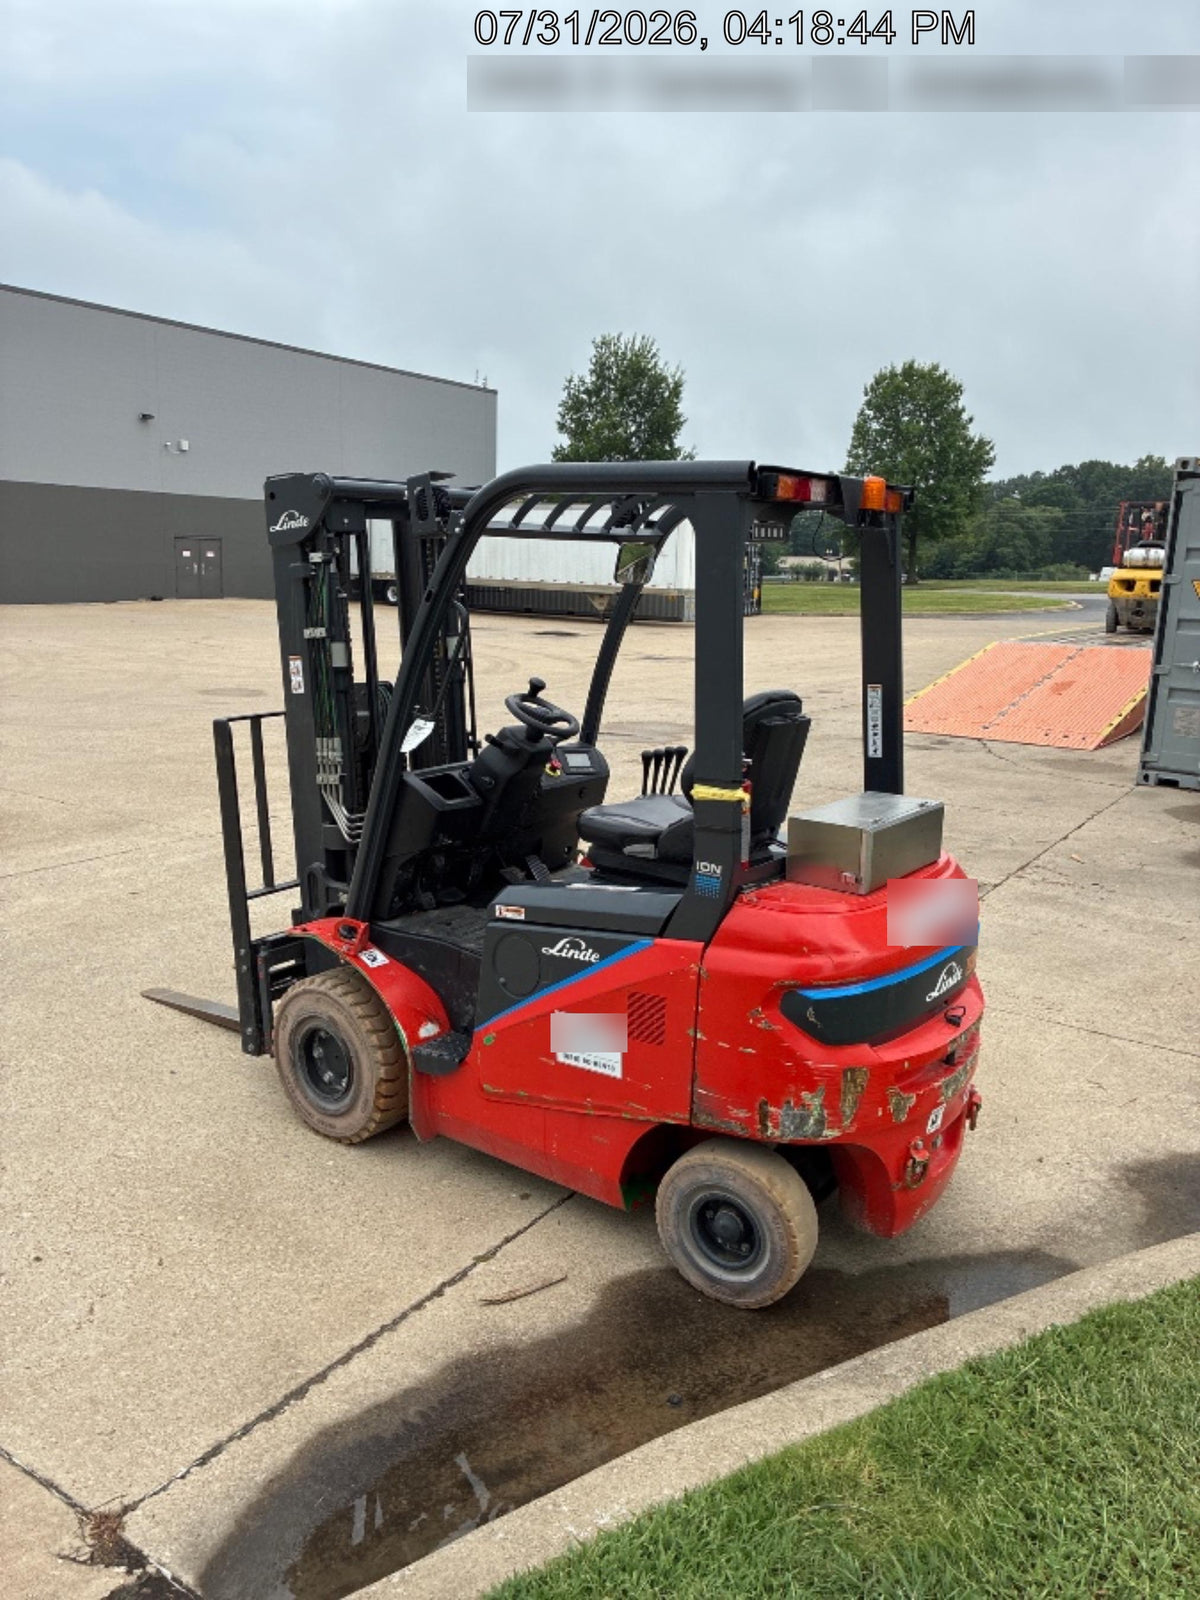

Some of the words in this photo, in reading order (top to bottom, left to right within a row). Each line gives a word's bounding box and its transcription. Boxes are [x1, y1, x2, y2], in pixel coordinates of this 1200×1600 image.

[269, 509, 310, 533] Linde
[696, 860, 723, 874] ION
[541, 936, 600, 963] Linde
[925, 961, 963, 1002] Linde
